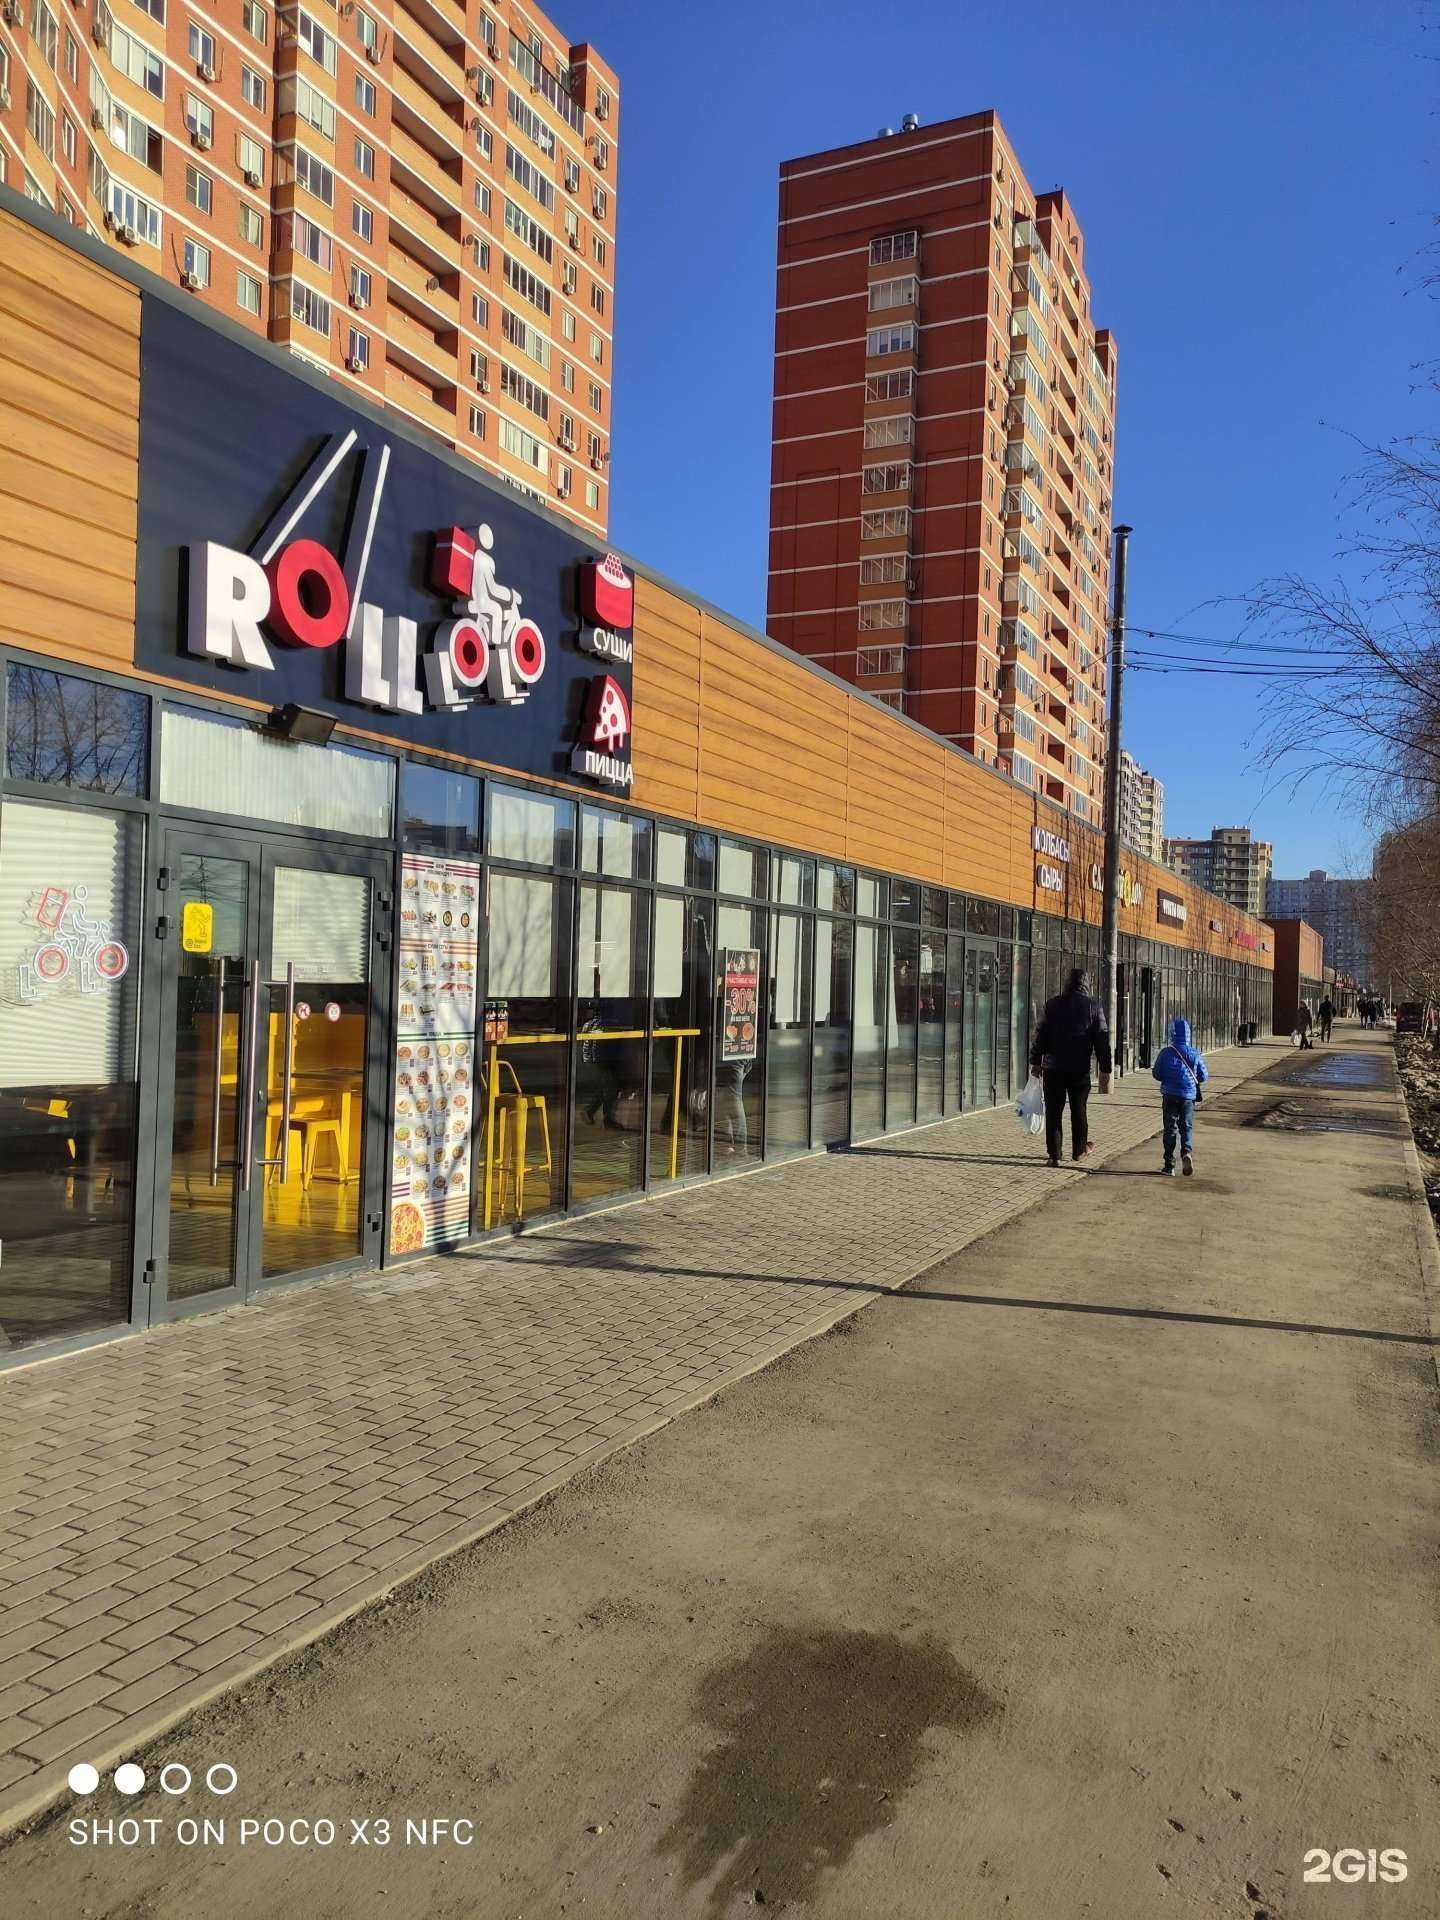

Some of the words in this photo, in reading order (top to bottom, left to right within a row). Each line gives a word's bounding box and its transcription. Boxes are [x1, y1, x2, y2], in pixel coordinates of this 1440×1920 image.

[593, 627, 633, 664] СУШИ
[585, 750, 635, 787] ПИЦЦА
[1034, 826, 1070, 863] КОЛБАСЫ
[1040, 863, 1064, 892] СЫРЫ
[725, 987, 757, 1015] -30%
